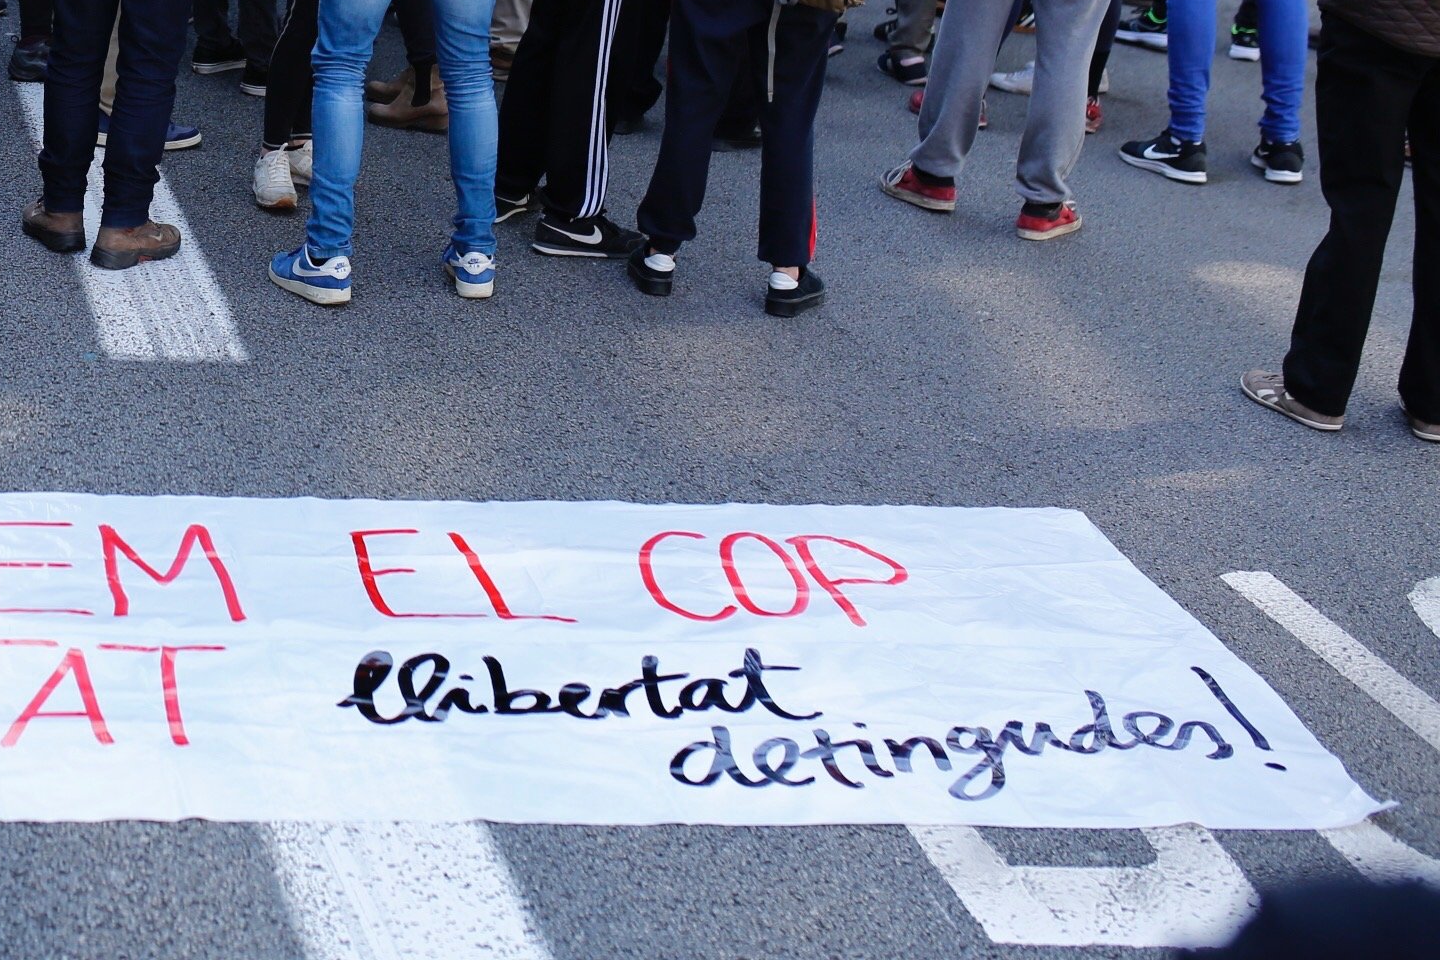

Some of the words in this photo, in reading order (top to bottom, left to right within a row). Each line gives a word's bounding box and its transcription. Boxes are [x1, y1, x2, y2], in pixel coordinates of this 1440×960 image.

[349, 528, 578, 624] EL
[638, 530, 911, 628] COP
[336, 648, 824, 725] llibertat
[669, 666, 1292, 801] detingudes!
